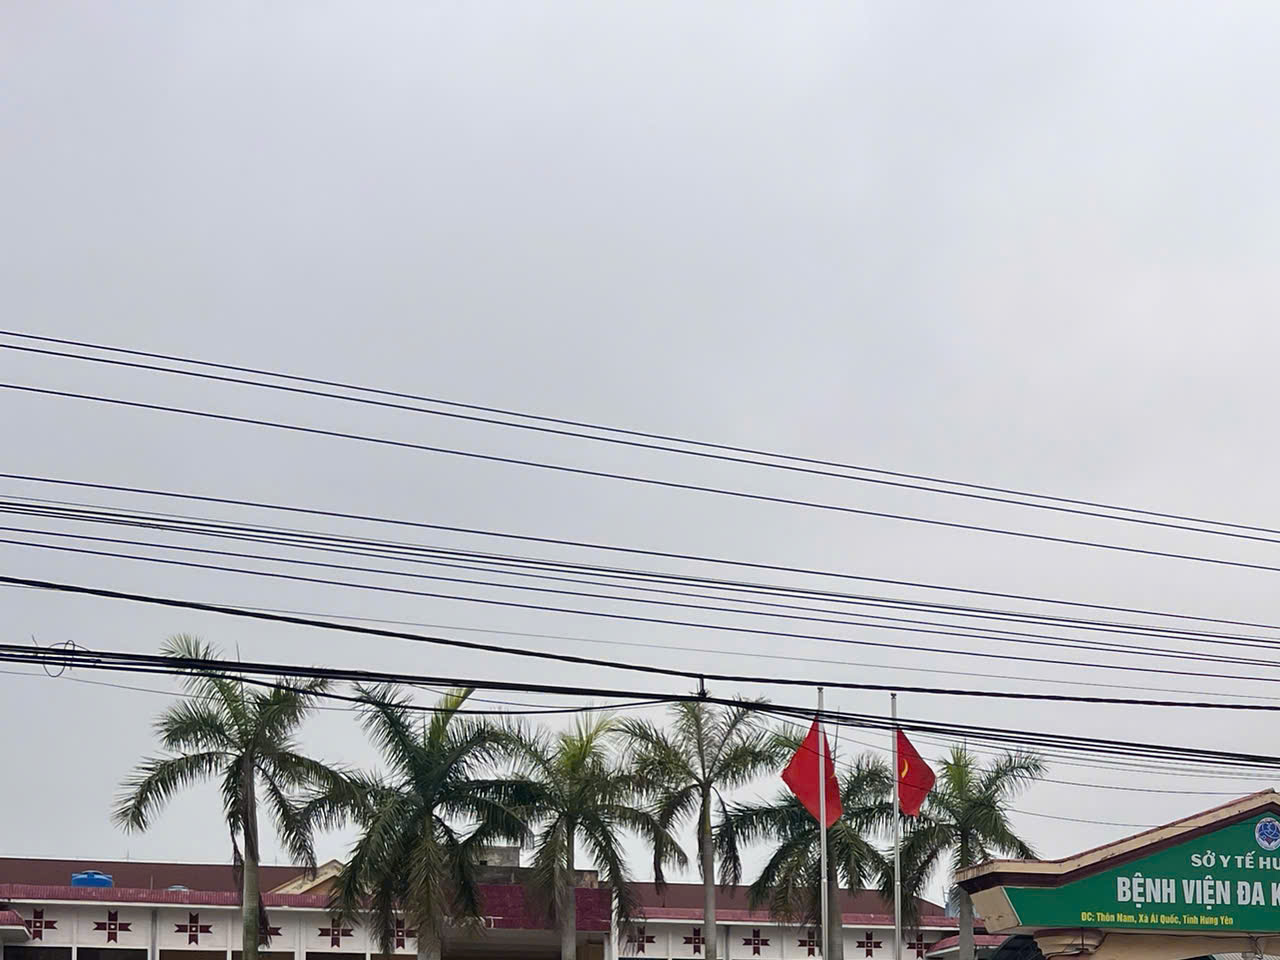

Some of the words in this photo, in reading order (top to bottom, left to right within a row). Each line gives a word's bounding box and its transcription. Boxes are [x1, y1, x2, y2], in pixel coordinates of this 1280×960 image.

[1191, 850, 1215, 867] SỞ
[1219, 855, 1231, 868] Y
[1234, 850, 1256, 869] TẾ
[1117, 872, 1176, 908] BỆNH
[1182, 875, 1231, 910] VIỆN
[1237, 880, 1265, 906] ĐA
[1096, 912, 1115, 923] Thôn
[1117, 913, 1137, 924] Nam,
[1220, 914, 1233, 926] Yên
